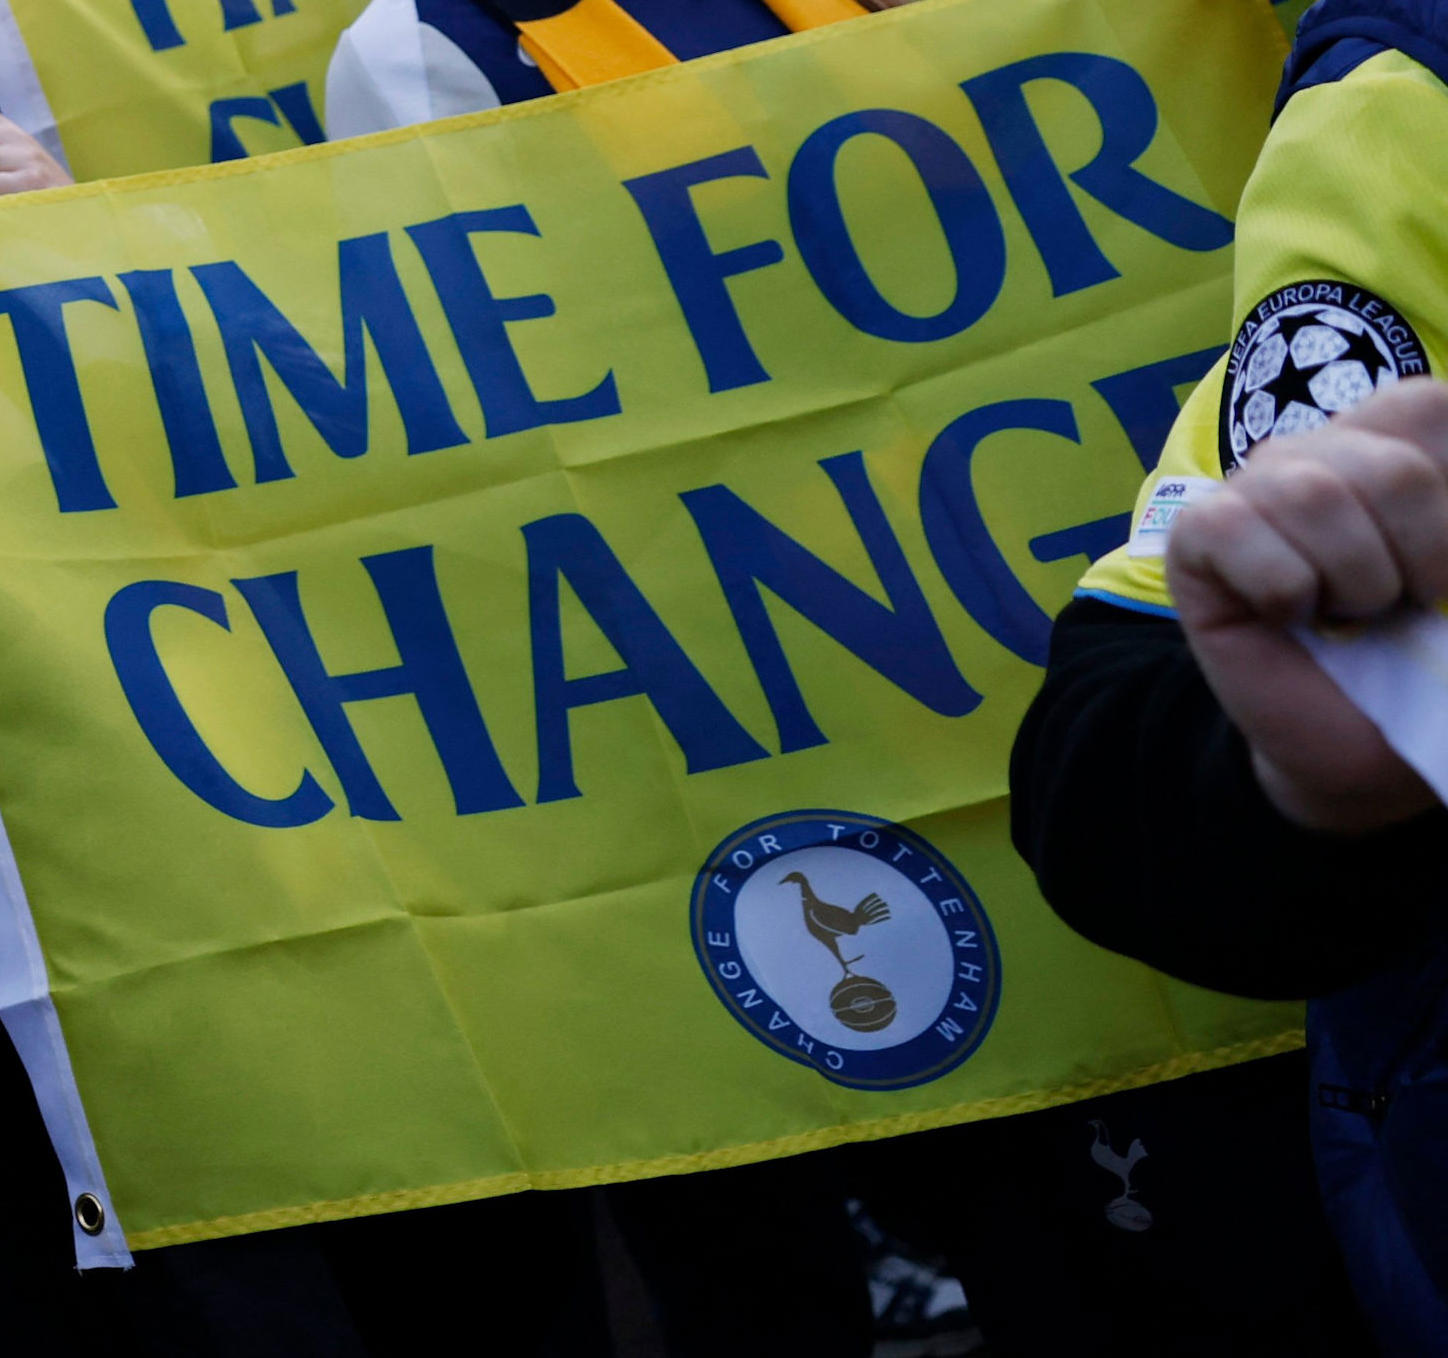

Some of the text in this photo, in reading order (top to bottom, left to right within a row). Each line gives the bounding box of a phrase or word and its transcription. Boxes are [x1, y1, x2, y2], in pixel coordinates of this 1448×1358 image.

[623, 50, 1235, 395] FOR
[1227, 283, 1425, 375] UEFA EUROPA LEAGUE
[706, 822, 985, 1072] CHANGE FOR TOTTENHAM
